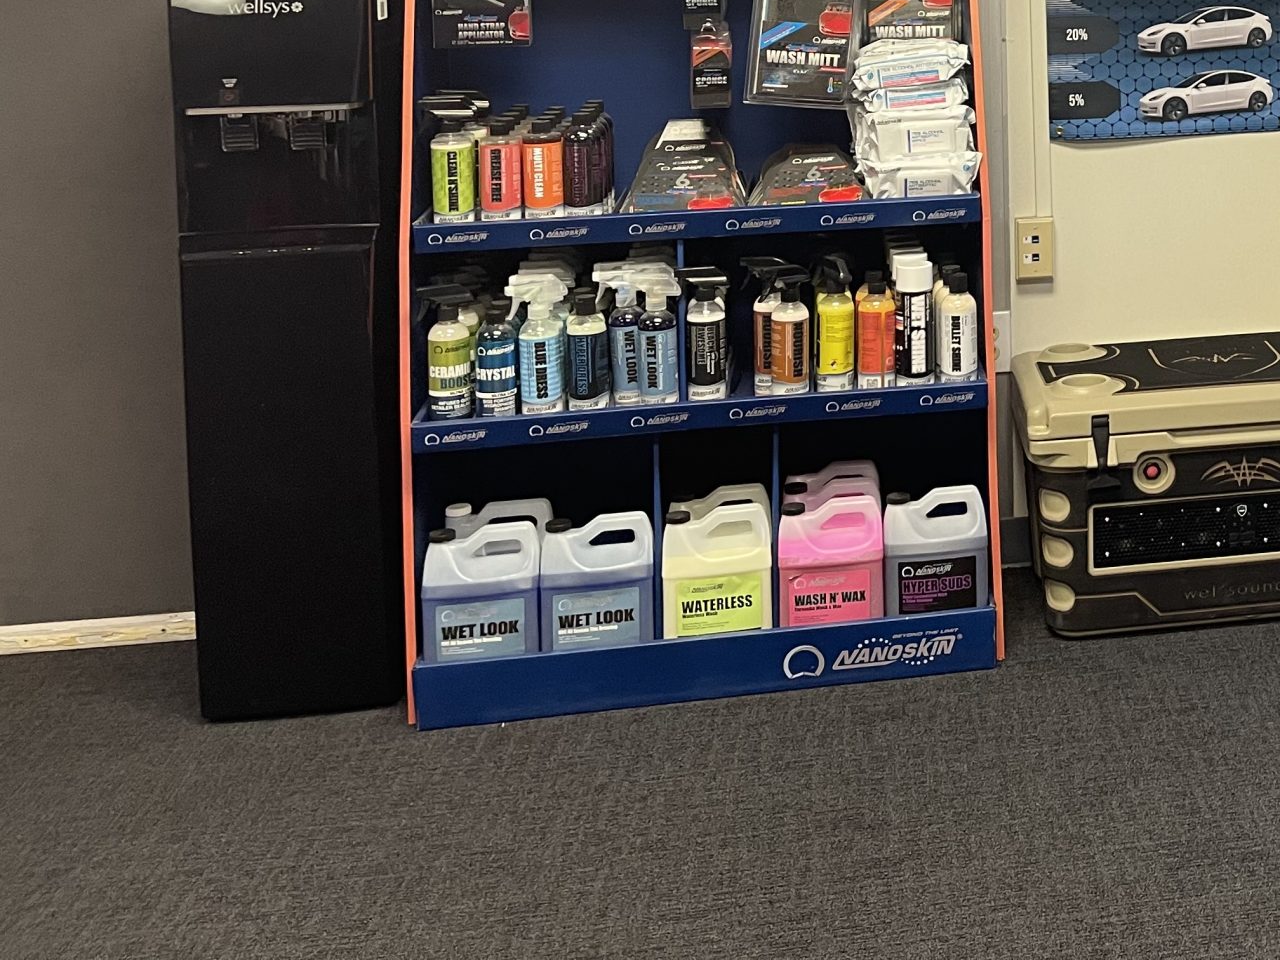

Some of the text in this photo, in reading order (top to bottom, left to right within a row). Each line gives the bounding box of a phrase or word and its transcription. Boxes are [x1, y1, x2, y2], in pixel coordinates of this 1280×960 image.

[457, 22, 505, 31] HAND STRAP
[458, 30, 505, 39] APPLICATOR
[875, 25, 946, 38] WASH MITT
[1066, 28, 1088, 41] 20%
[766, 49, 841, 67] WASH MITT
[695, 76, 728, 85] SPONGE
[1068, 93, 1085, 107] 5%
[447, 151, 457, 178] CLEAN
[533, 147, 544, 198] MULTI CLEAN
[806, 165, 820, 179] 6
[490, 148, 502, 203] GREASE FREE
[675, 173, 691, 187] 6
[740, 218, 782, 228] NANOSKIN
[835, 214, 875, 224] NANOSKIN
[546, 228, 588, 239] NANOSKIN
[644, 223, 686, 233] NANOSKIN
[624, 330, 635, 352] WET
[911, 293, 926, 374] WET SHINE
[646, 335, 656, 359] WET
[697, 326, 707, 365] AWESOME
[792, 321, 804, 378] NOURISH
[951, 315, 961, 372] BULLET SHINE
[476, 365, 516, 381] CRYSTAL
[534, 340, 549, 400] BLUE DRESS
[576, 336, 588, 395] HYPER DRESS
[625, 356, 638, 384] LOOK
[646, 362, 658, 389] LOOK
[840, 399, 881, 411] NANOSKIN
[934, 392, 975, 404] NANOSKIN
[647, 413, 688, 425] NANOSKIN
[745, 406, 786, 417] NANOSKIN
[546, 422, 589, 434] NANOSKIN
[441, 431, 486, 443] NANOSKIN
[902, 574, 972, 594] HYPER SUDS
[682, 594, 753, 614] WATERLESS
[794, 590, 866, 607] WASH N' WAX
[558, 608, 635, 629] WET LOOK
[441, 619, 519, 640] WET LOOK
[832, 635, 956, 671] NANOSKIN
